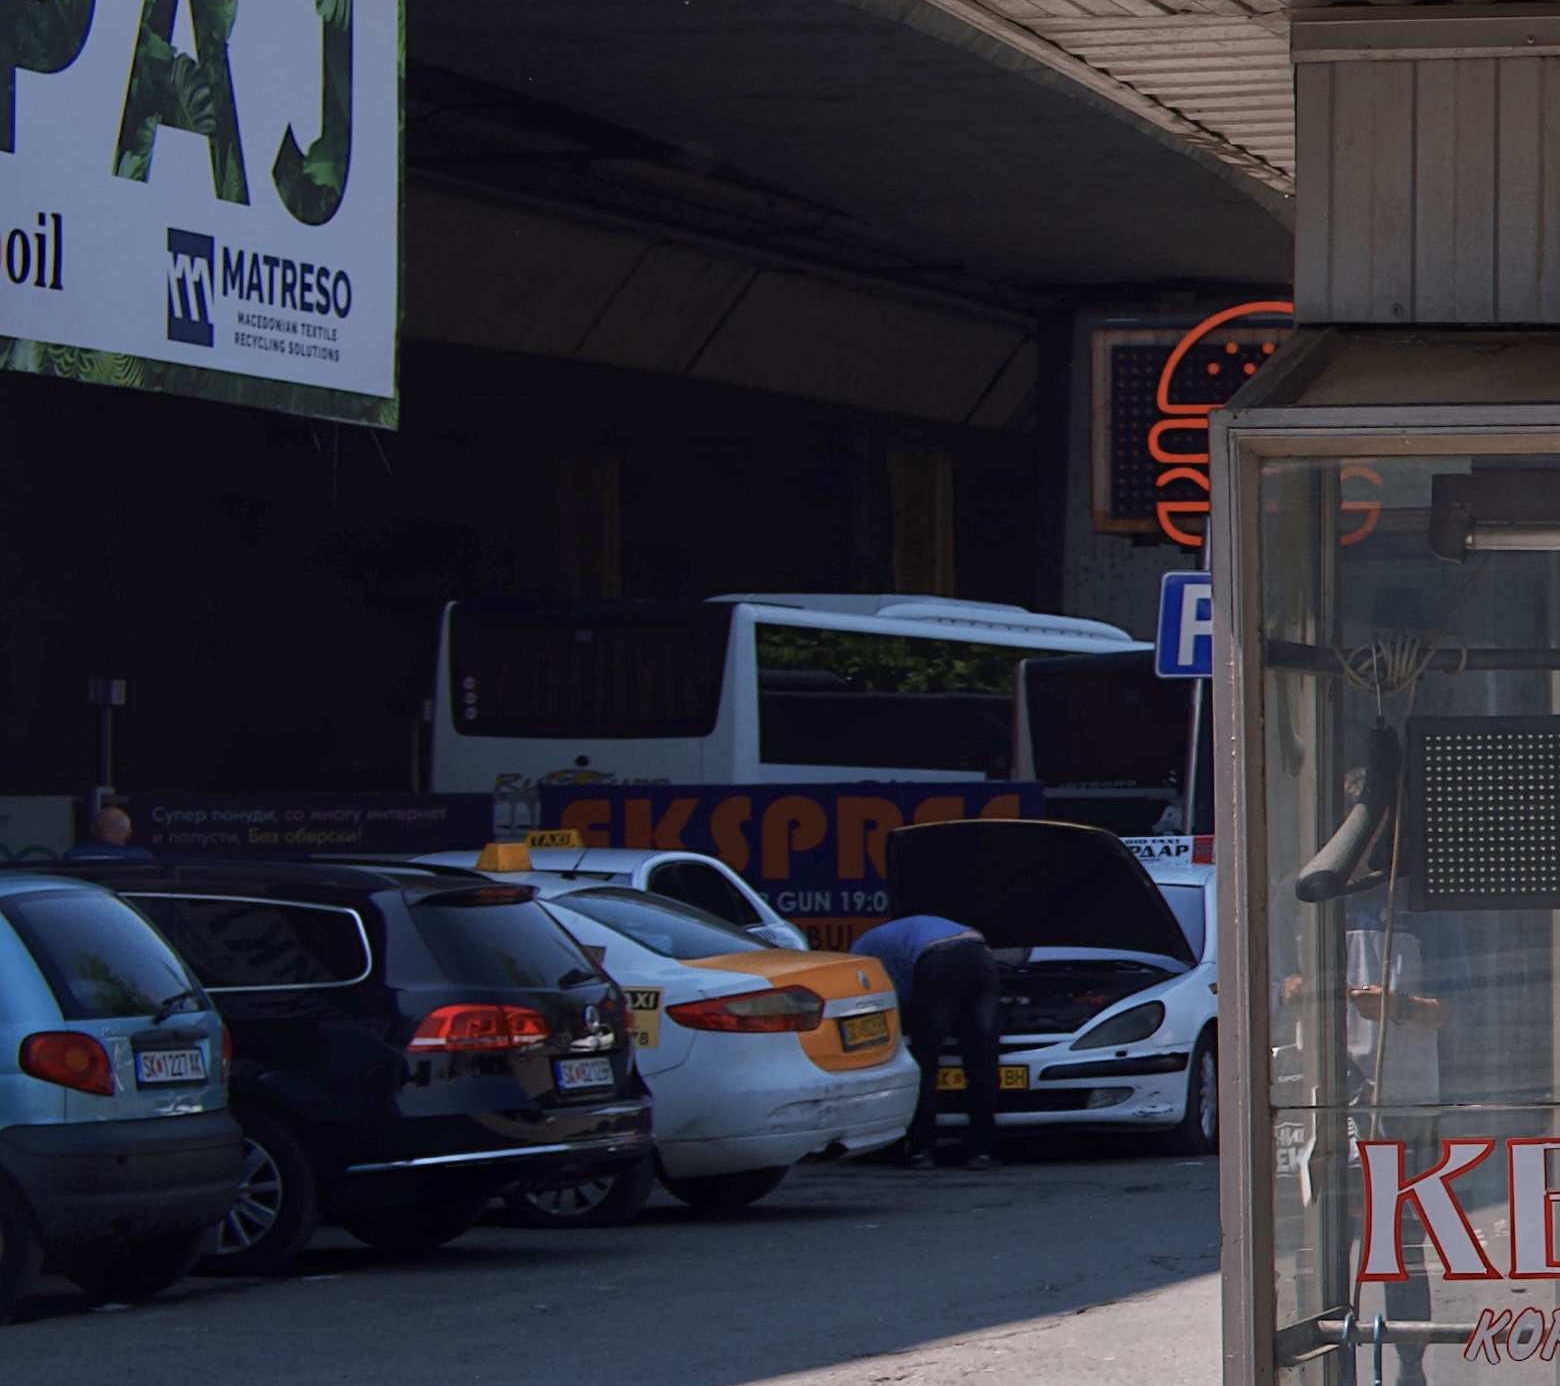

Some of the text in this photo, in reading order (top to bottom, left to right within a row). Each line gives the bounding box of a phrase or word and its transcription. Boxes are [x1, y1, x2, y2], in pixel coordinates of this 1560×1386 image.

[222, 245, 353, 319] MATRESO
[237, 312, 338, 342] MACEDONIAN TEXTILE
[234, 331, 340, 363] RECYCLING SOLUTIONS
[152, 805, 207, 824] Супер
[284, 809, 305, 821] со
[309, 809, 362, 825] многу
[367, 807, 448, 824] интернет
[152, 833, 163, 845] и
[248, 827, 279, 844] Без
[529, 832, 571, 848] TAXI
[777, 892, 832, 913] GUN
[841, 892, 888, 913] 19:0
[143, 1054, 158, 1078] SK
